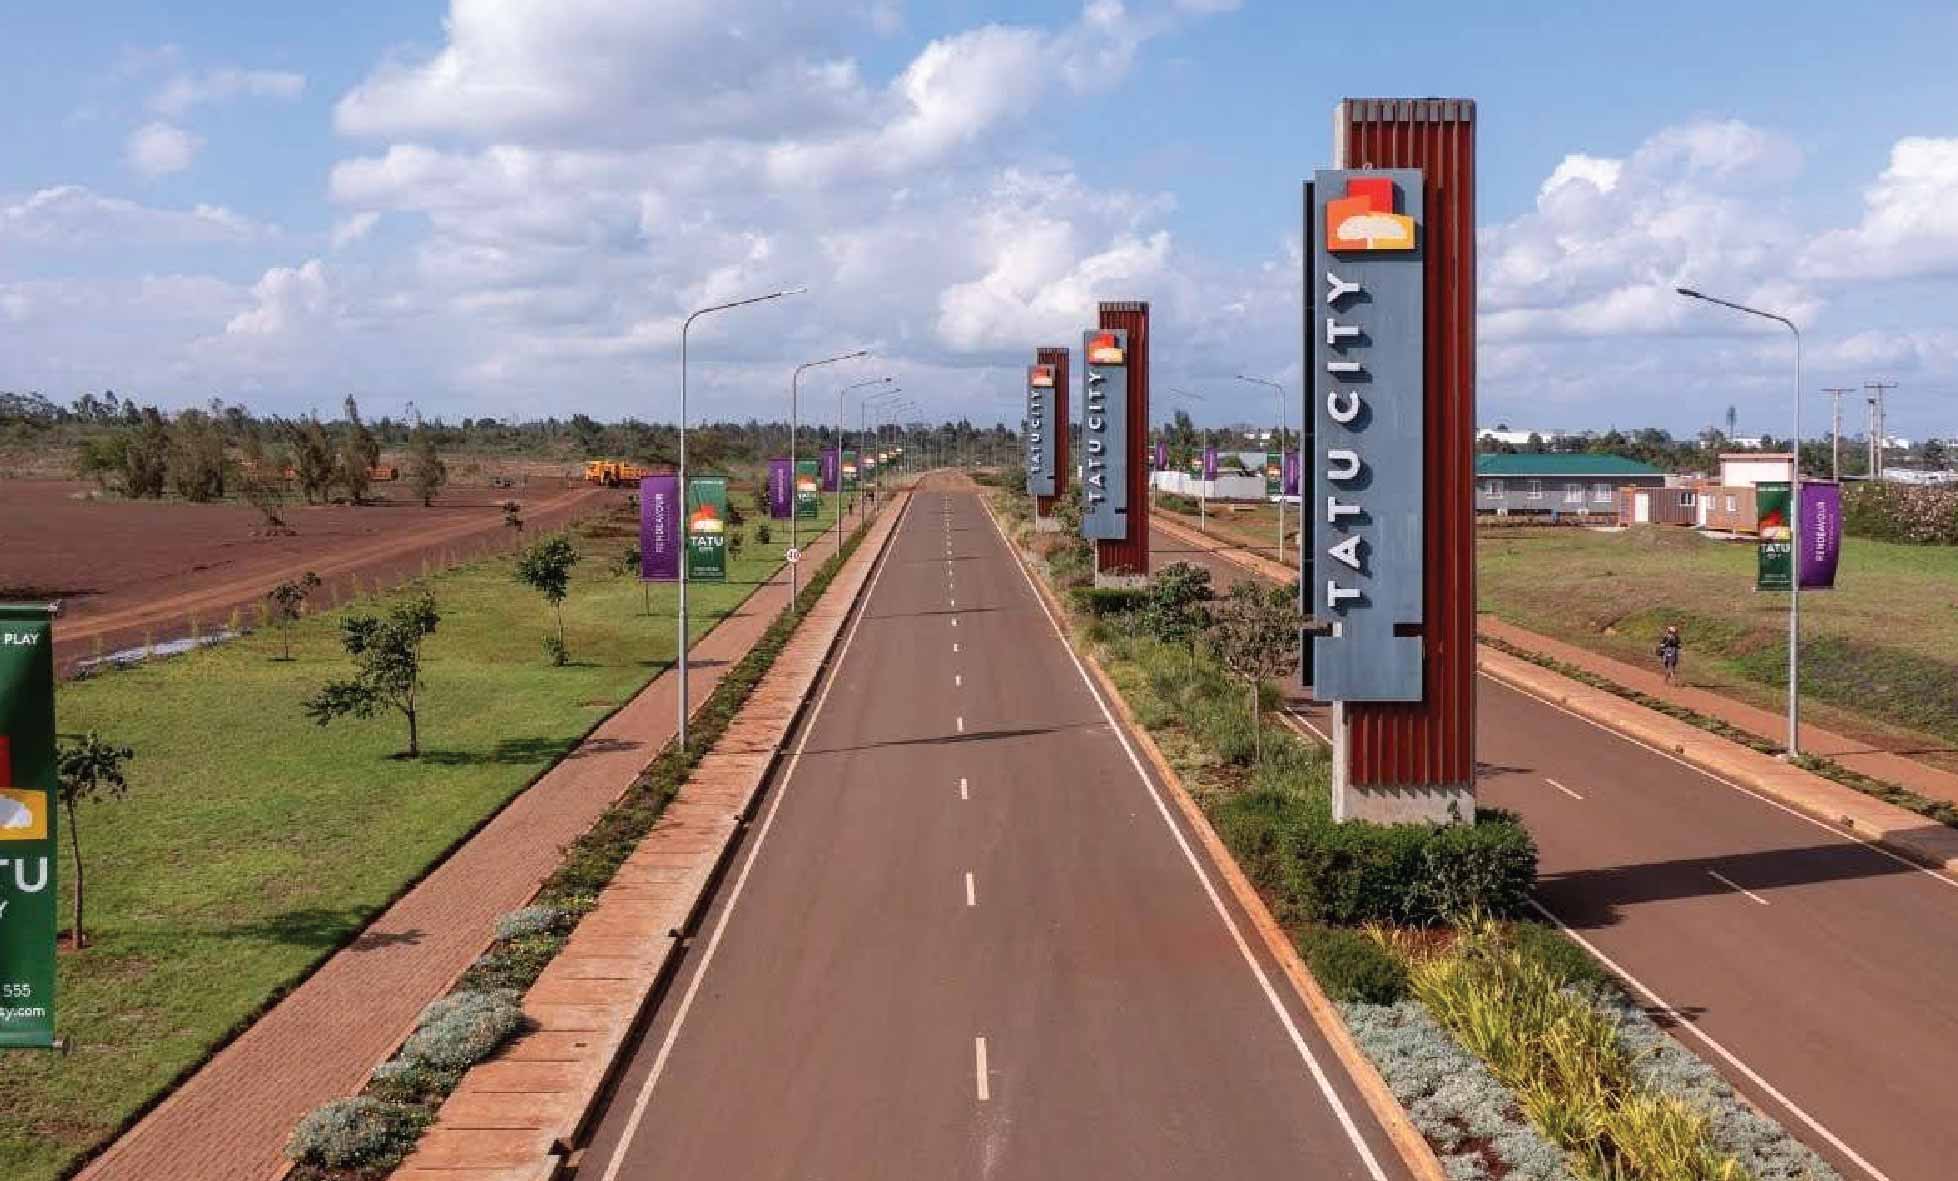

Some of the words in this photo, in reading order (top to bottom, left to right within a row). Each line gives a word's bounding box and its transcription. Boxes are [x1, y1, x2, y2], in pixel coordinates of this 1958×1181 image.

[1327, 273, 1361, 423] CITY
[1088, 371, 1102, 430] CITY
[1088, 440, 1102, 504] TATU
[690, 536, 724, 547] TATU
[1327, 448, 1361, 607] TATU
[4, 632, 40, 645] PLAY
[3, 982, 31, 998] 555
